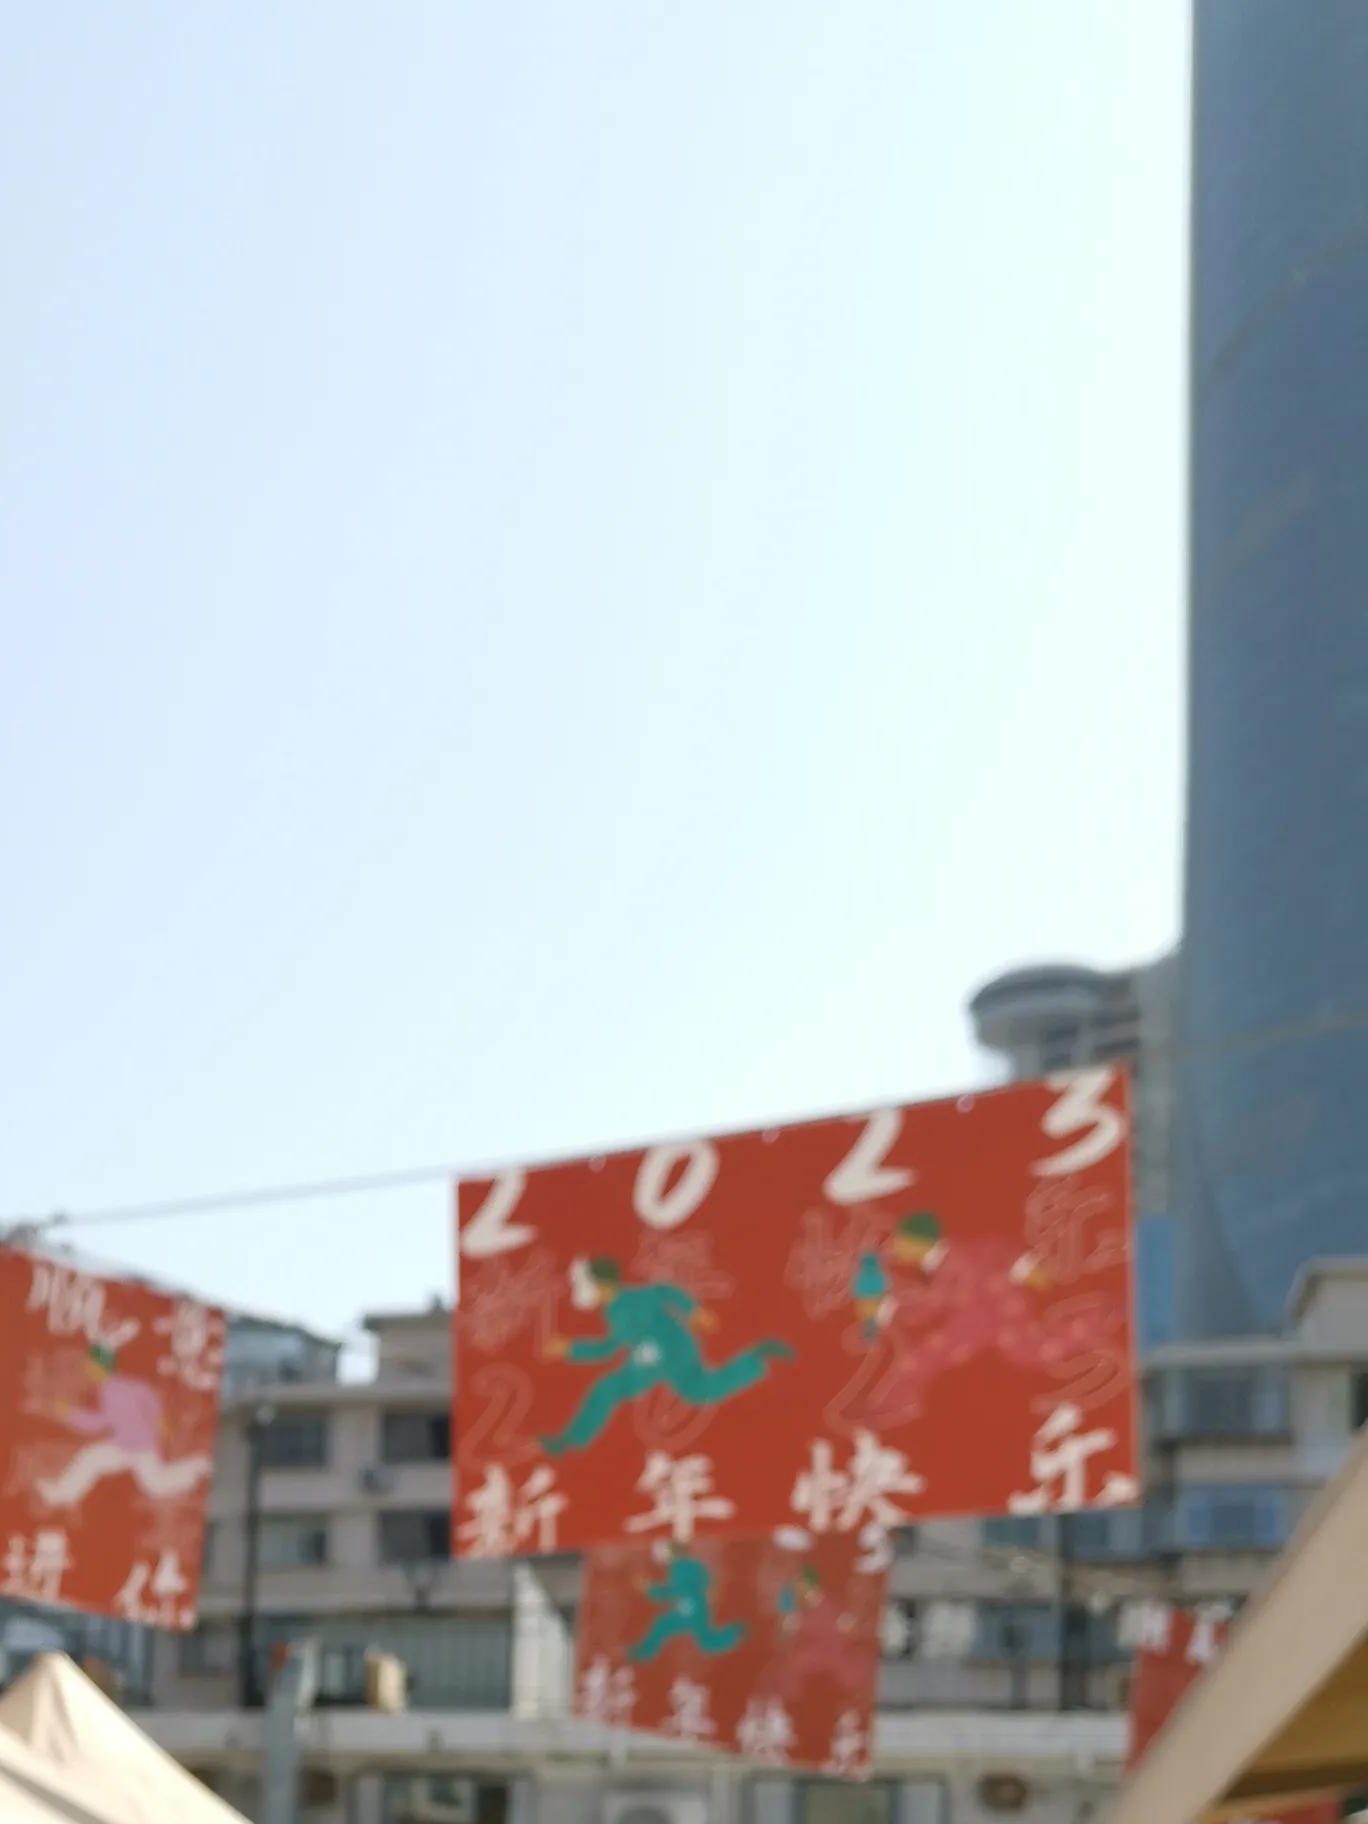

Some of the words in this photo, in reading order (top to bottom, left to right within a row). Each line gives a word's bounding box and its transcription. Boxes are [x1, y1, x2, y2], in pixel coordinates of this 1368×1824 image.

[460, 1066, 1125, 1258] 2023
[457, 1404, 1138, 1557] 新年快乐
